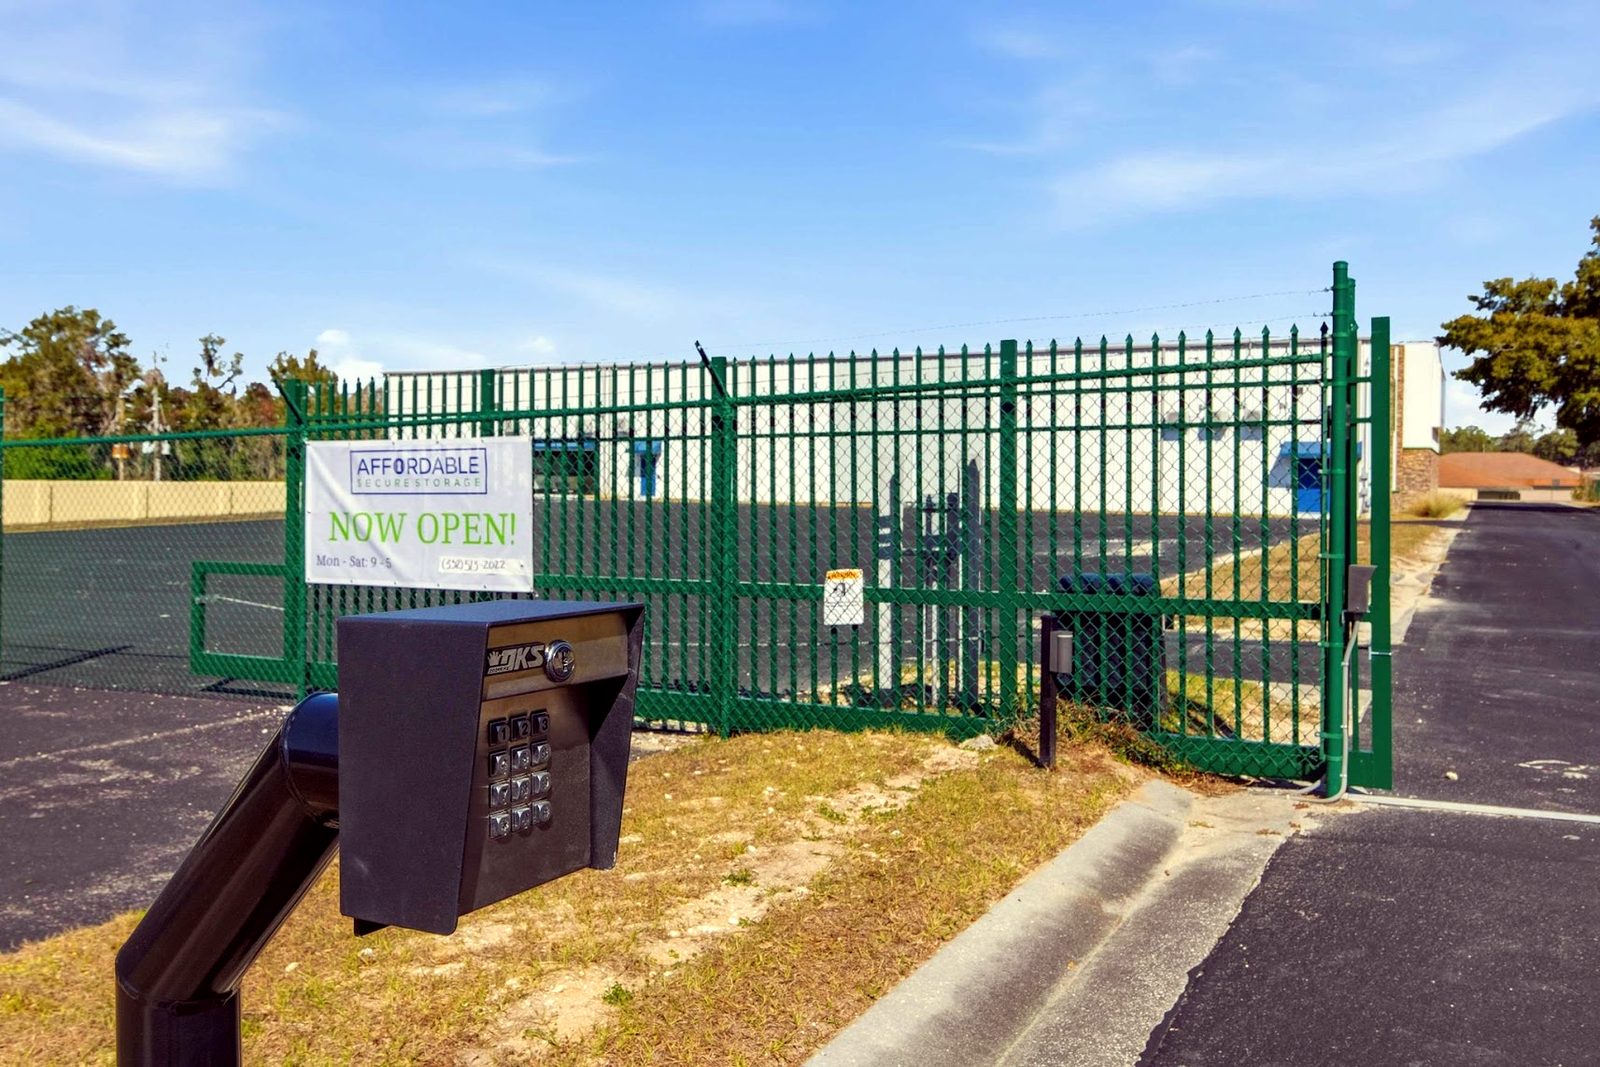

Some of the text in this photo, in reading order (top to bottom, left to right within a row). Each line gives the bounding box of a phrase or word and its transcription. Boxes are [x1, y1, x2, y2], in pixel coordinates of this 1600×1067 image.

[357, 456, 480, 475] AFFORDABLE
[328, 511, 517, 545] NOW OPEN!
[316, 555, 340, 567] Mon
[349, 555, 368, 568] Sat:
[370, 556, 377, 567] 9
[521, 722, 529, 736] 2
[541, 718, 549, 731] 3
